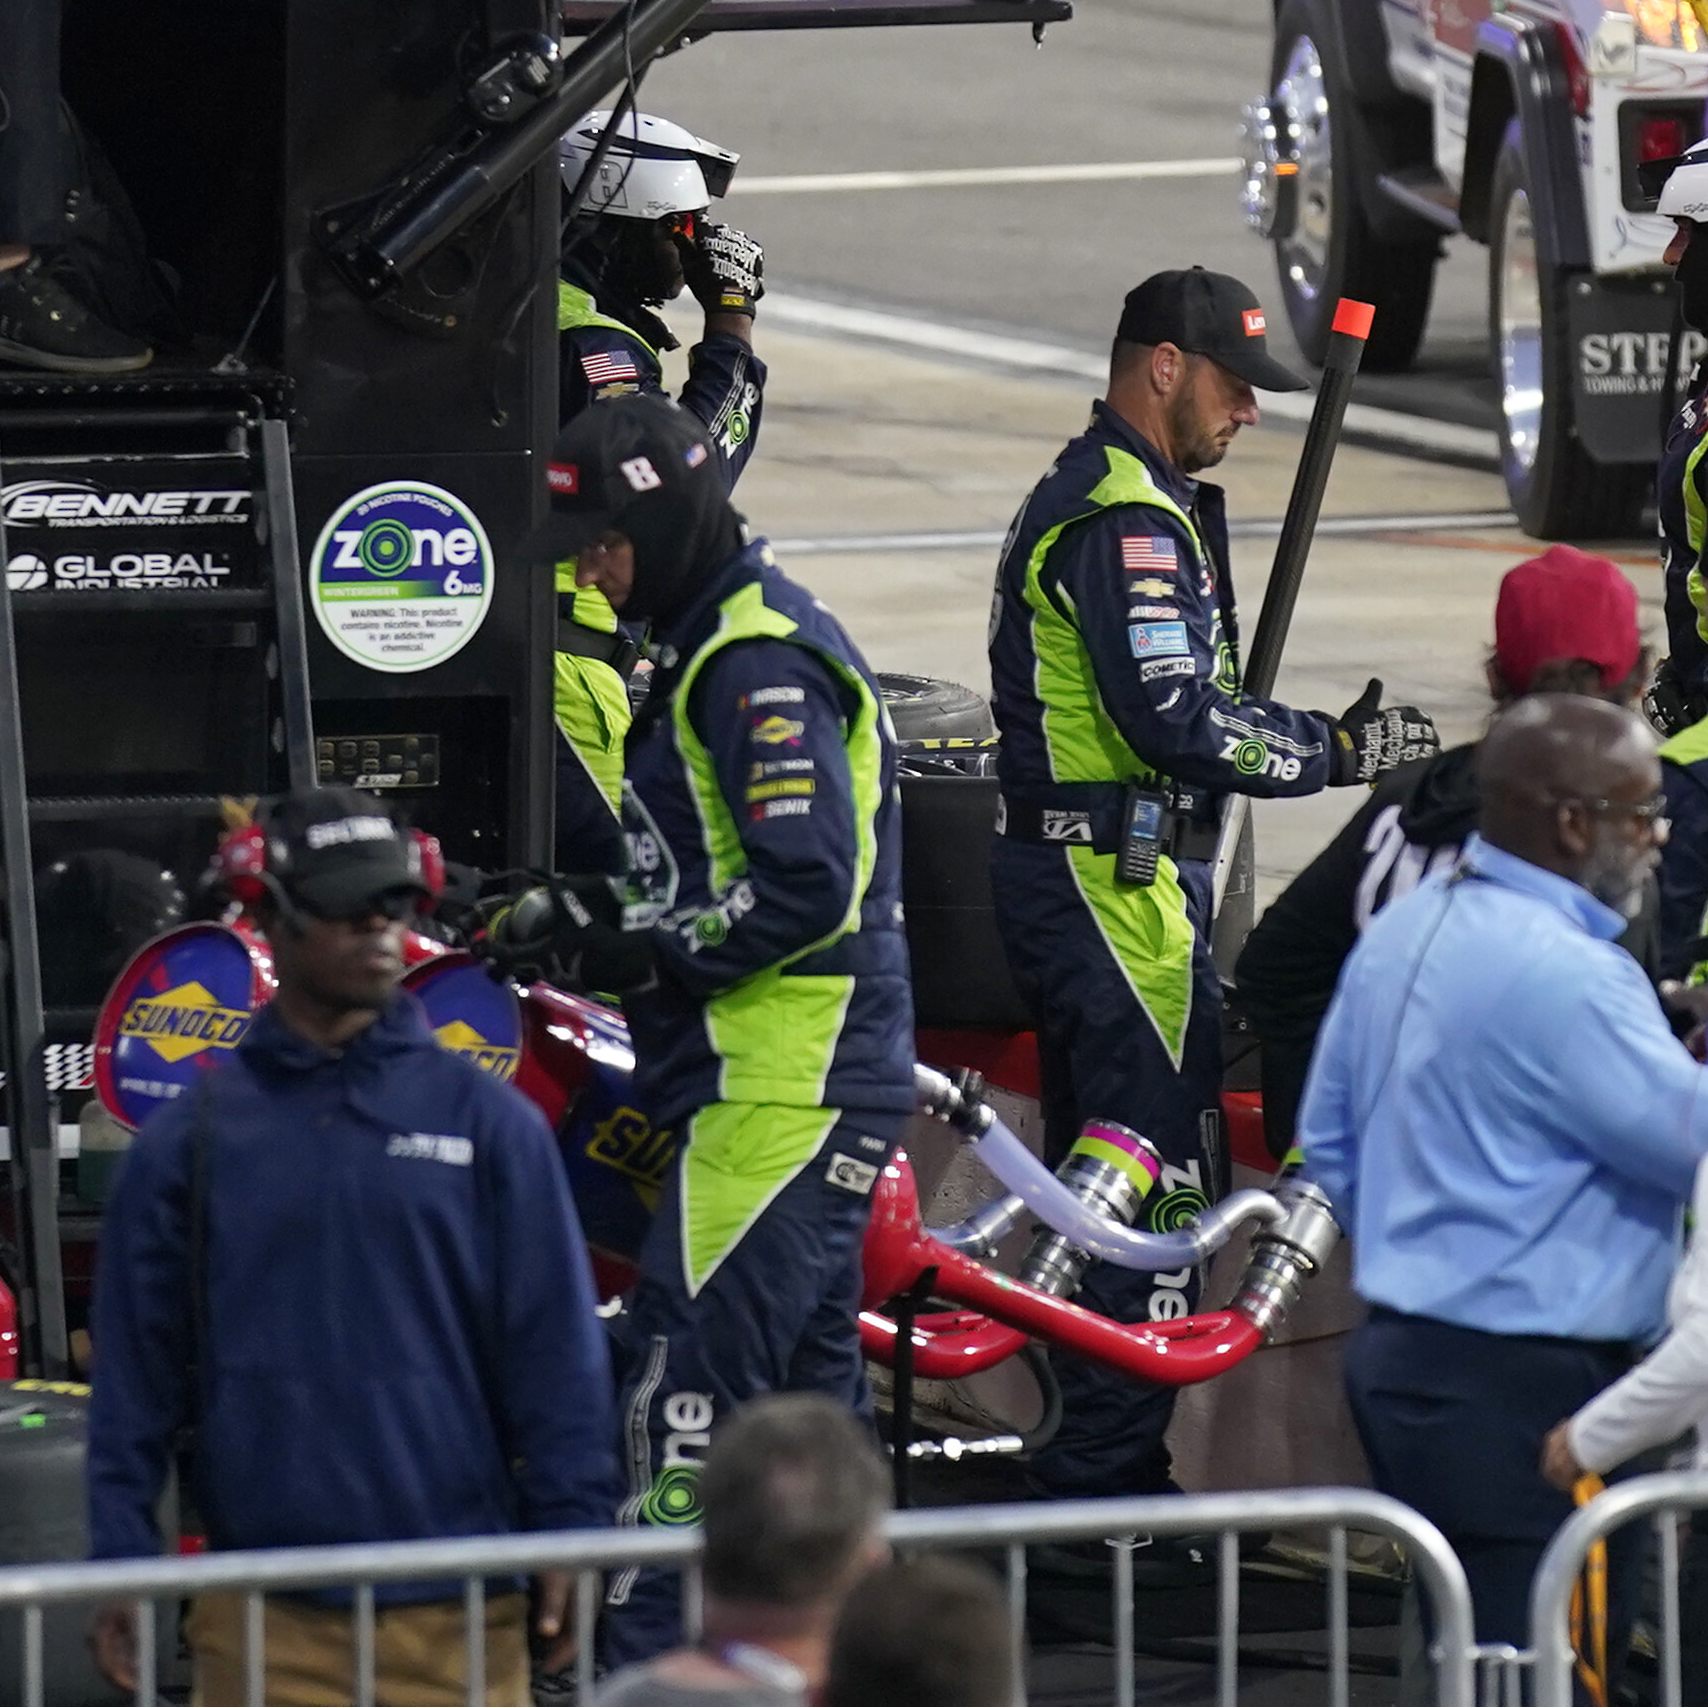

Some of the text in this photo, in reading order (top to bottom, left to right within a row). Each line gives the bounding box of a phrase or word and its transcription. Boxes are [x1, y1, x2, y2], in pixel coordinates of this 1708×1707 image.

[620, 456, 663, 492] 8
[6, 490, 253, 519] BENNETT
[178, 513, 249, 526] LOGISTICS
[332, 518, 478, 578] zone
[53, 553, 231, 580] GLOBAL
[1219, 734, 1303, 782] zone
[124, 1001, 251, 1043] SUNOCO
